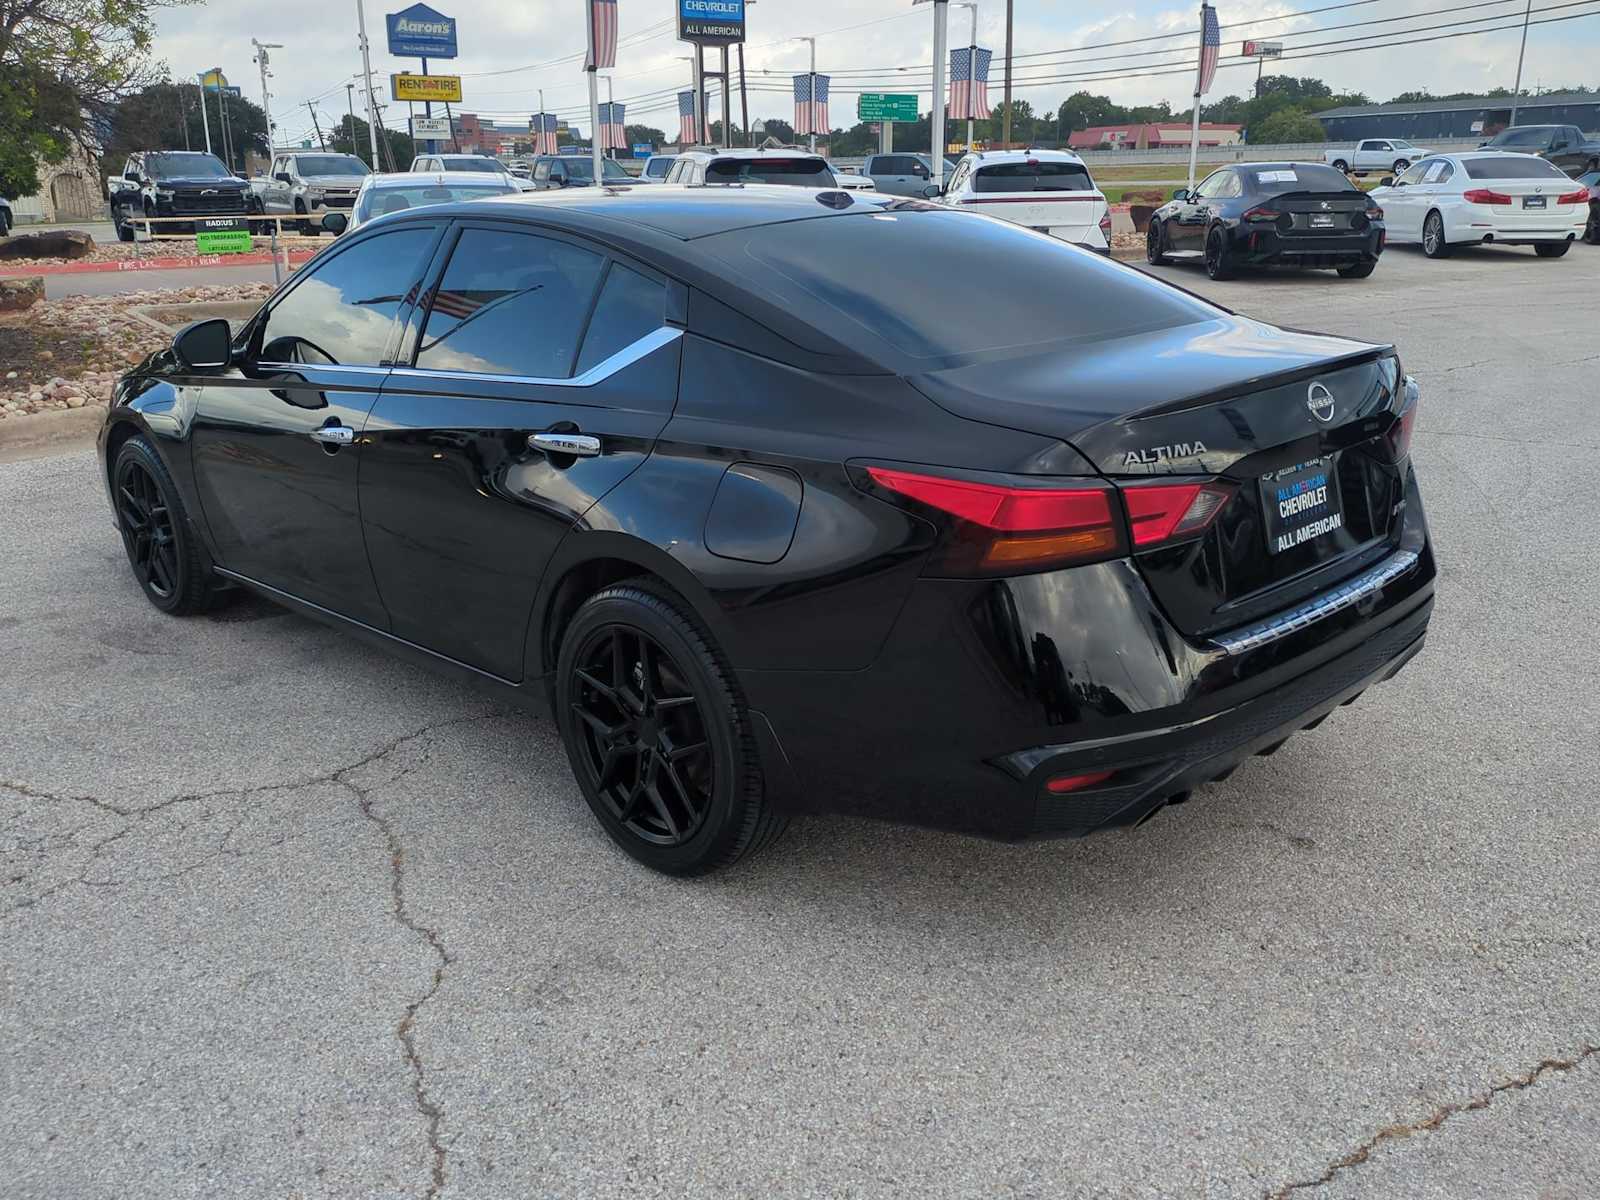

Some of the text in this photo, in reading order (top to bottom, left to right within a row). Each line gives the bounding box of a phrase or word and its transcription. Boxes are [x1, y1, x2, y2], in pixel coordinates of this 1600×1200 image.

[685, 0, 739, 13] CHEVROLET
[396, 18, 449, 34] Aaron's
[686, 24, 741, 36] ALL AMERICAN
[1124, 440, 1207, 465] ALTIMA
[1279, 486, 1327, 518] CHEVROLET
[1278, 513, 1341, 552] ALL AMERICAN
